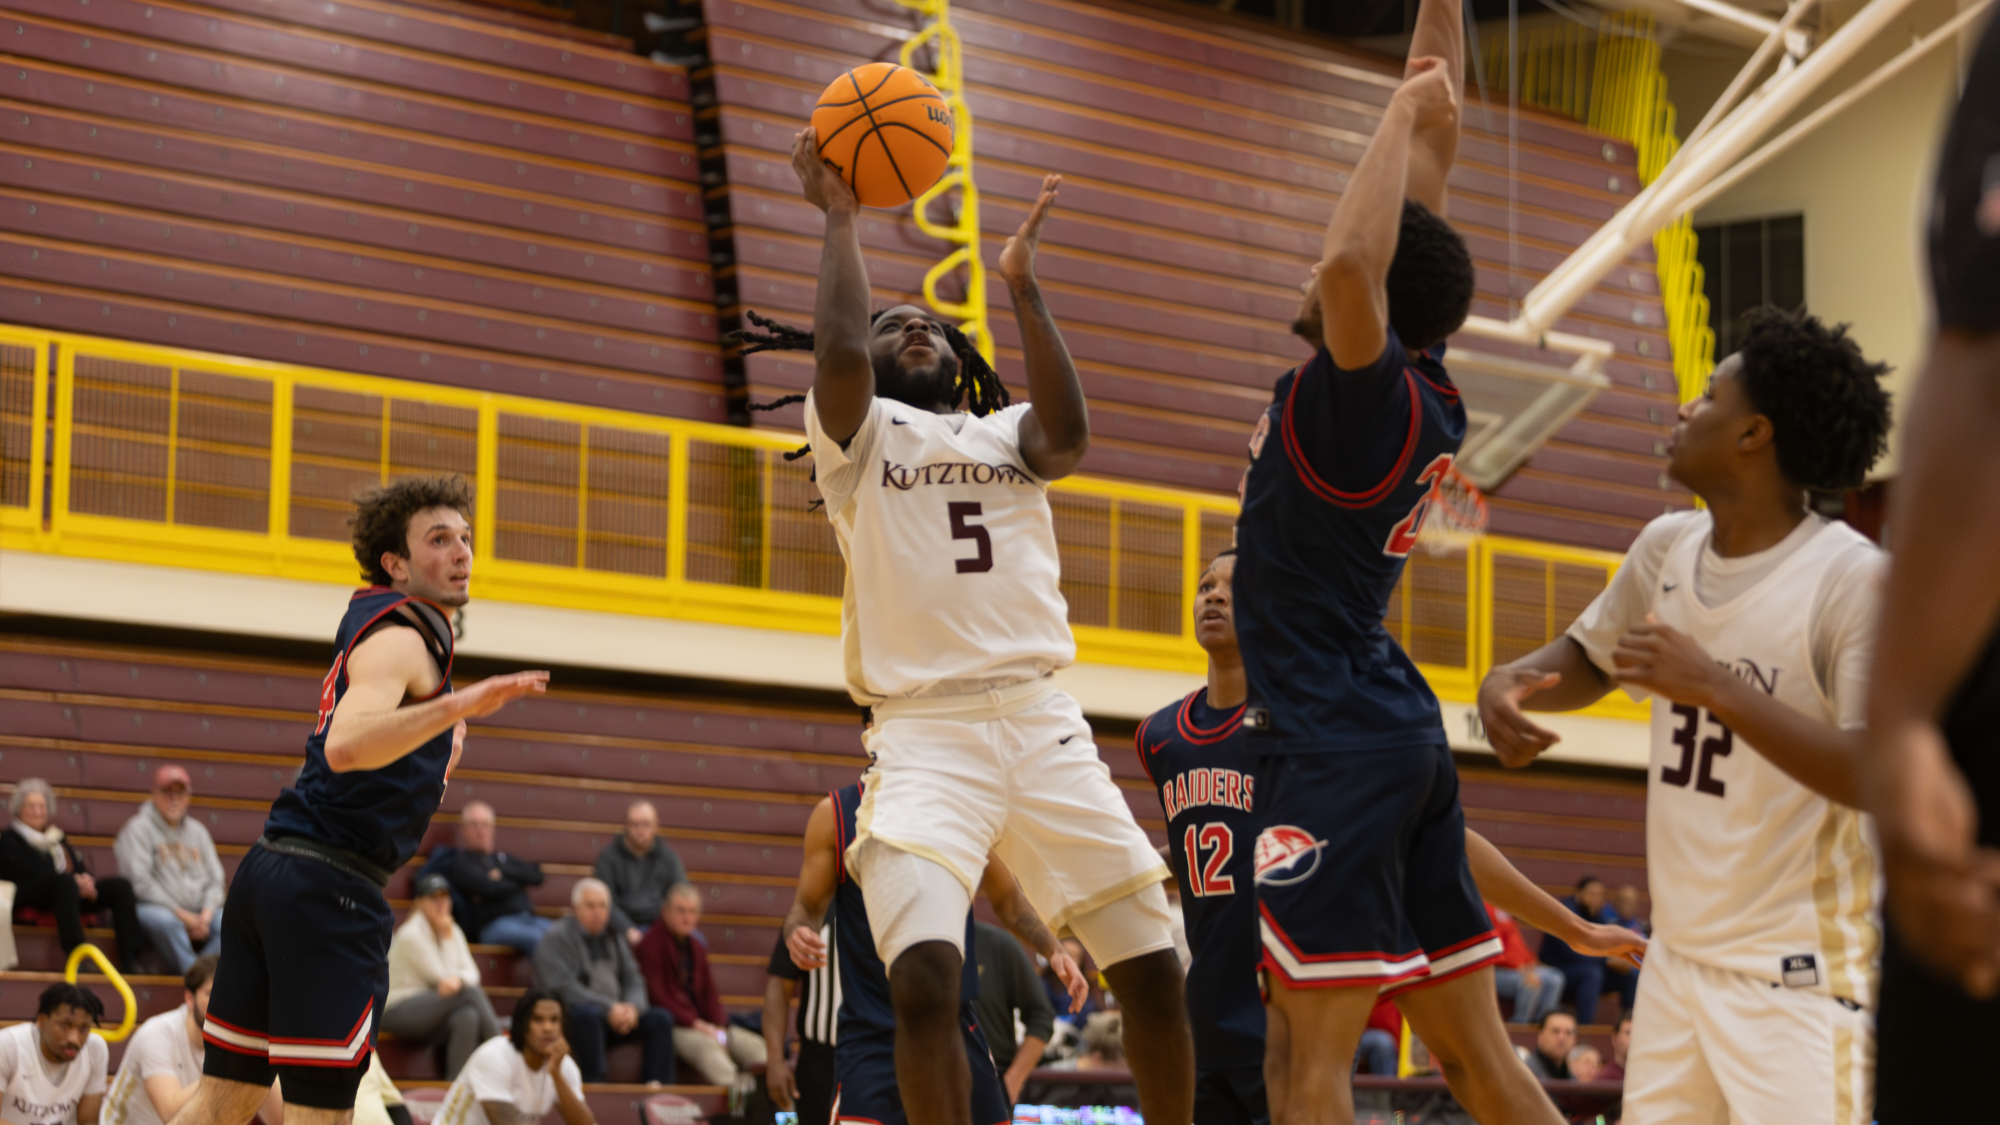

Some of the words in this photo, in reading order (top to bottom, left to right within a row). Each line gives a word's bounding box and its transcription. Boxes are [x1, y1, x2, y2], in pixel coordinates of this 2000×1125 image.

[947, 501, 993, 574] 5
[1661, 702, 1733, 798] 32
[1163, 767, 1254, 823] RAIDERS
[1184, 821, 1235, 897] 12
